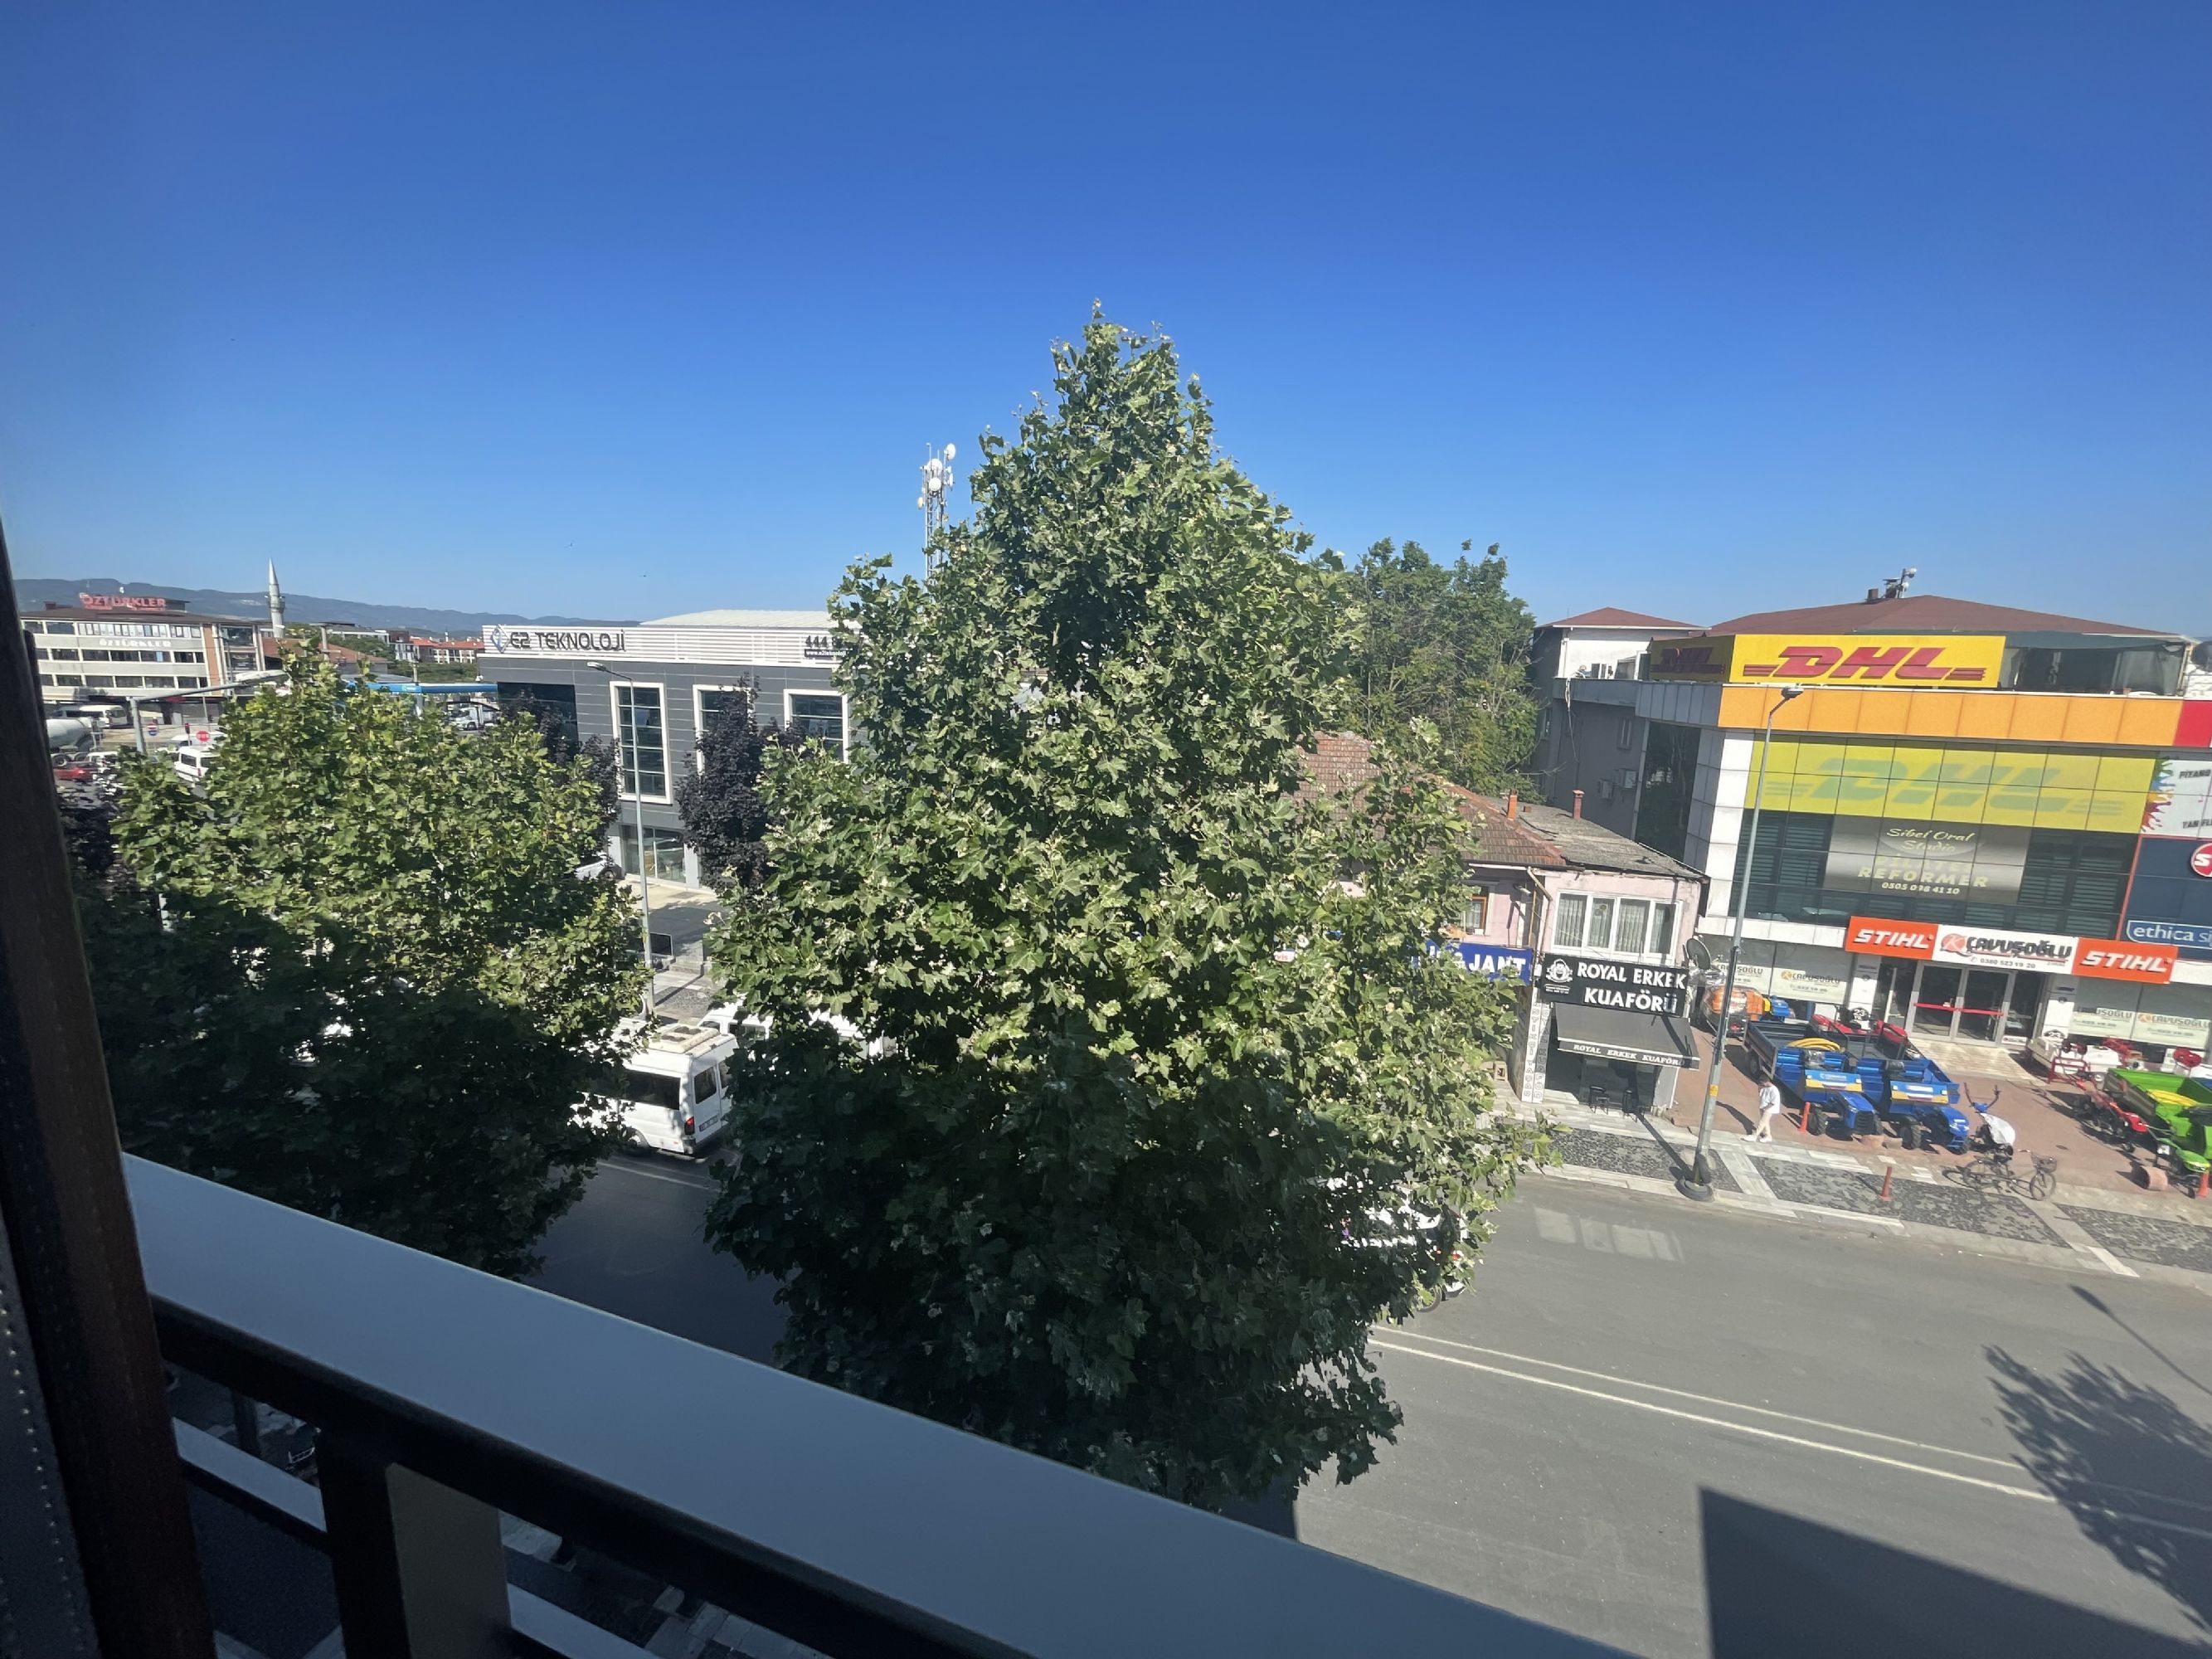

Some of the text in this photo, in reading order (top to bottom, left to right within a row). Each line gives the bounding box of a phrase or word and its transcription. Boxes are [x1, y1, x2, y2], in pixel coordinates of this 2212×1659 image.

[535, 629, 626, 652] TEKNOLOJİ
[805, 635, 828, 648] 444
[1772, 646, 1952, 679] DHL
[1808, 757, 2075, 813] DHL
[1858, 866, 1989, 888] REFORMER
[1853, 928, 1929, 949] STIHL
[2133, 925, 2195, 941] ethica
[1966, 937, 2073, 958] ÇAVUŞOĞLU
[2080, 951, 2167, 973] STIHL
[1577, 961, 1687, 990] ROYAL ERKEK
[1584, 987, 1678, 1014] KUAFÖRÜ
[1573, 1044, 1602, 1054] ROYAL
[1607, 1049, 1637, 1059] ERKEK
